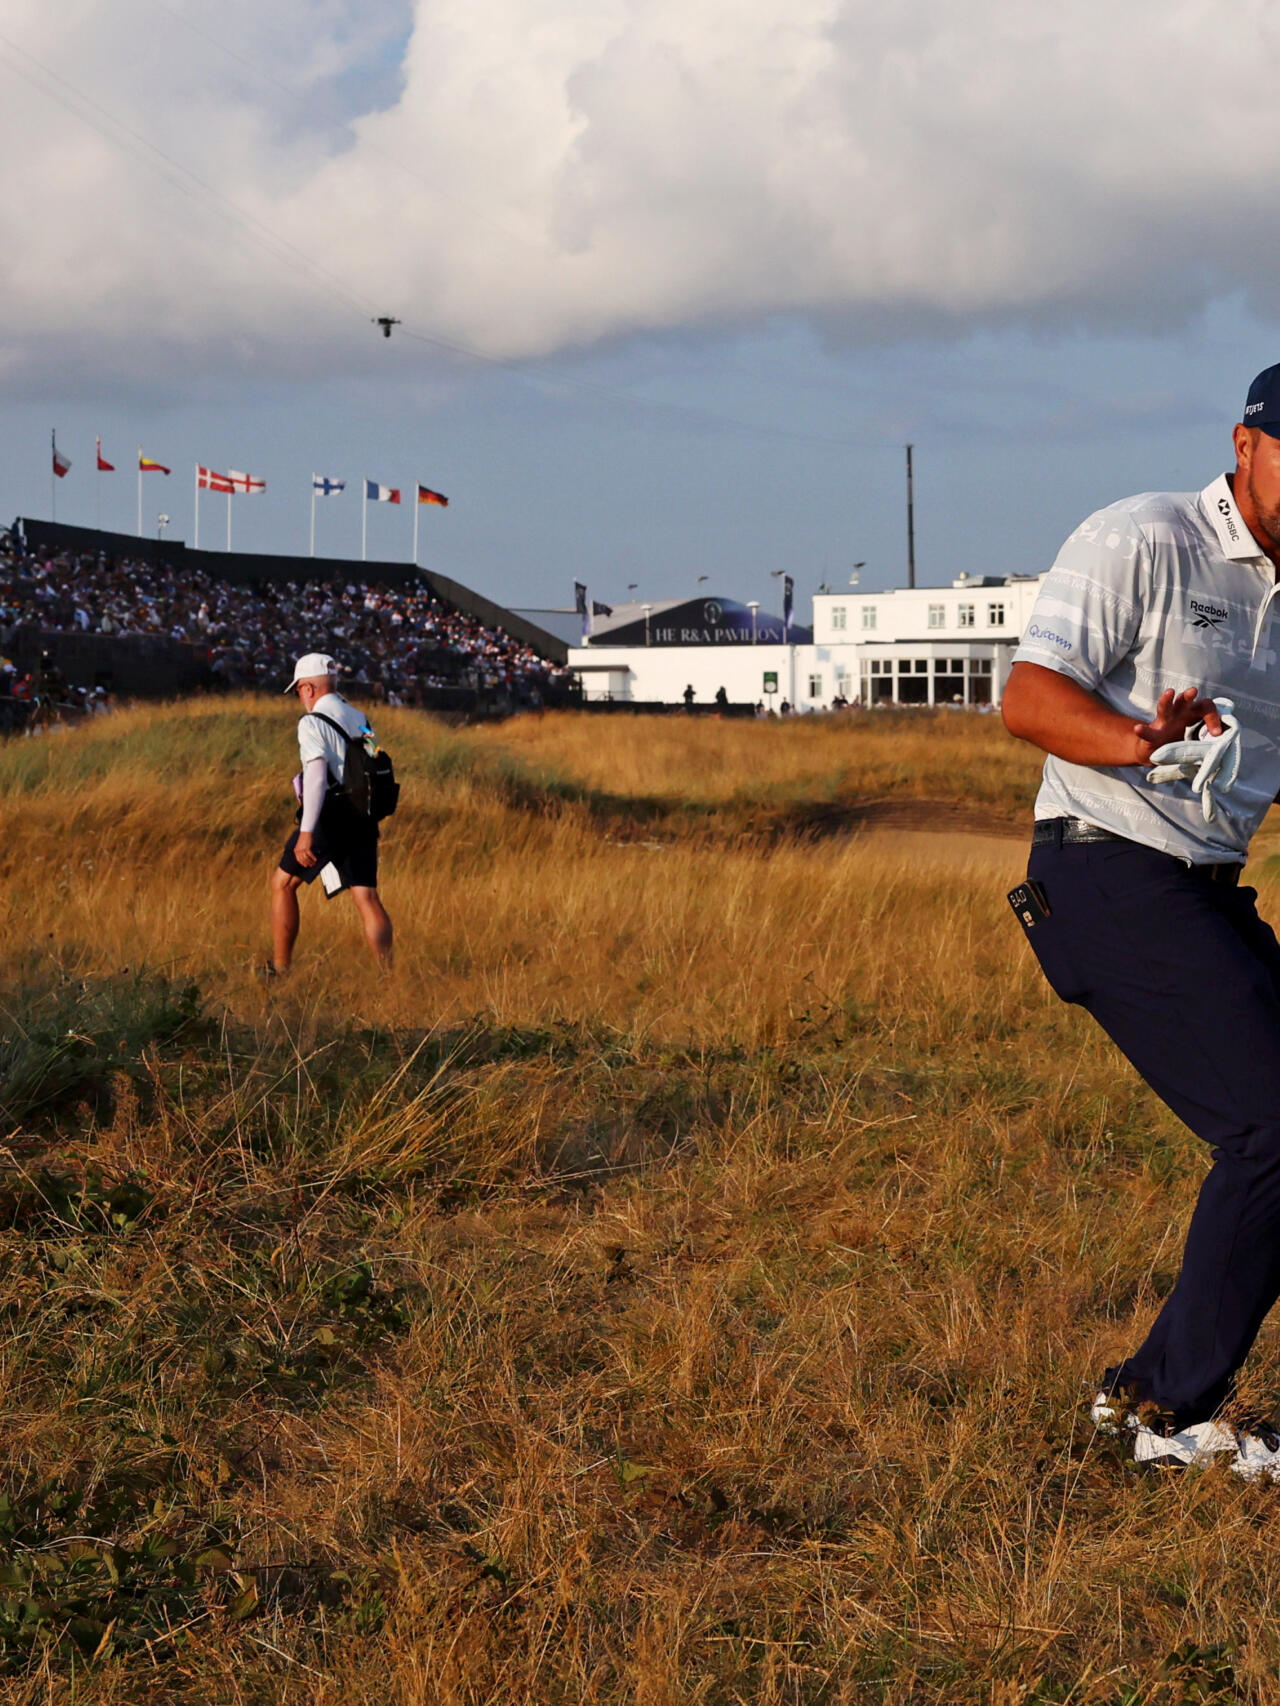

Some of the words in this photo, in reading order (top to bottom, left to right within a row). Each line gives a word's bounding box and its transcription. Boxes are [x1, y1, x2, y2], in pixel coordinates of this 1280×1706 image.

[1225, 517, 1240, 542] HSBC
[1190, 600, 1229, 620] Reebok
[655, 628, 676, 641] HE
[680, 628, 711, 641] R&A
[714, 628, 780, 641] PAVILON
